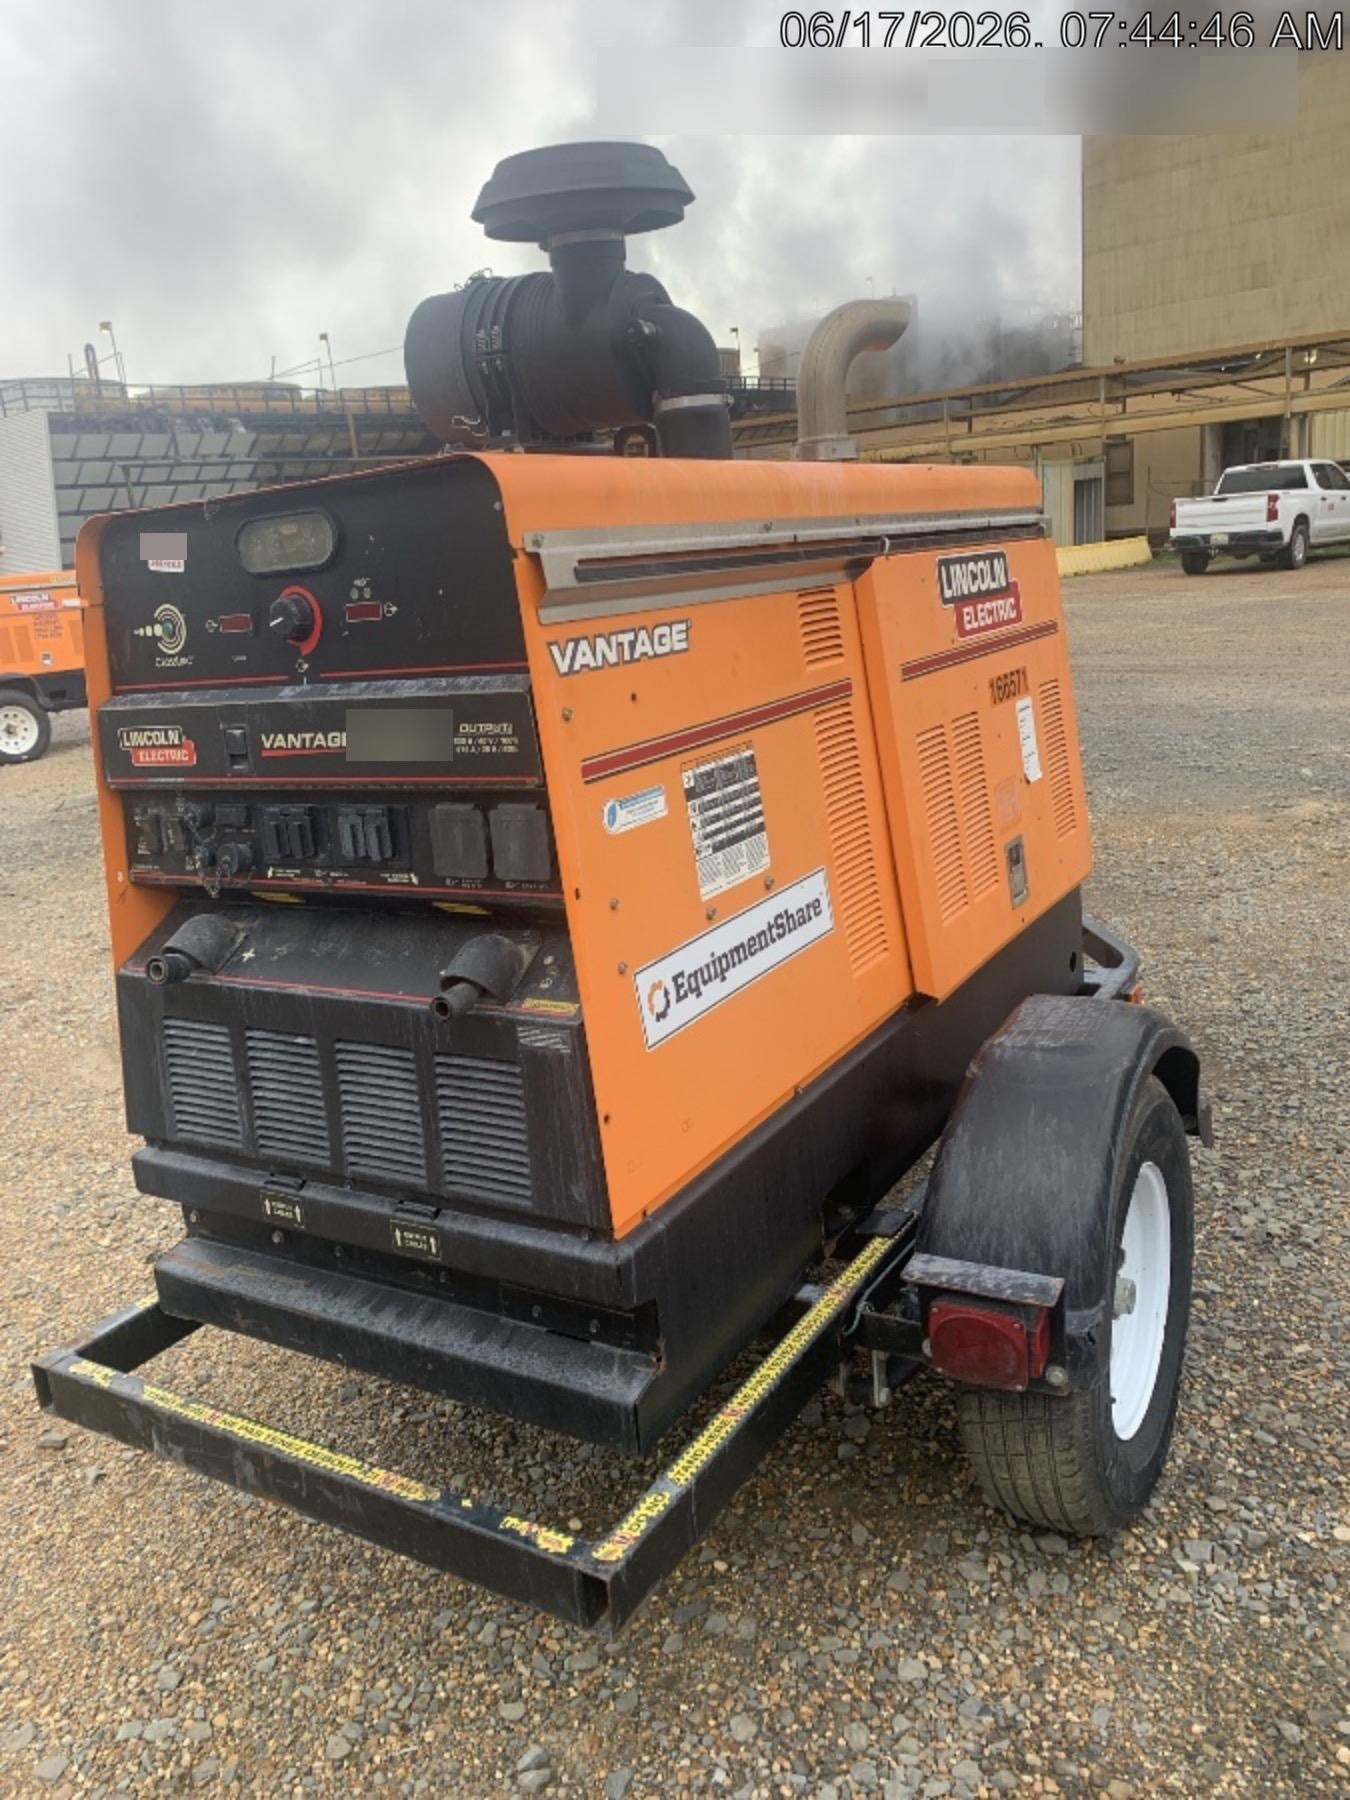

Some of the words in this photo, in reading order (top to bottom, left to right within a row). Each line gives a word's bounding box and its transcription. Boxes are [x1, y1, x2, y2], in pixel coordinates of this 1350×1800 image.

[941, 558, 1006, 598] LINCOLN
[962, 598, 1017, 630] ELECTRIC
[548, 620, 689, 675] VANTAGE
[989, 666, 1029, 704] 166571
[123, 730, 180, 747] LINCOLN
[140, 749, 189, 762] ELECTRIC
[672, 898, 822, 1003] EquipmentShare
[624, 1510, 649, 1535] DO
[644, 1490, 667, 1515] NO
